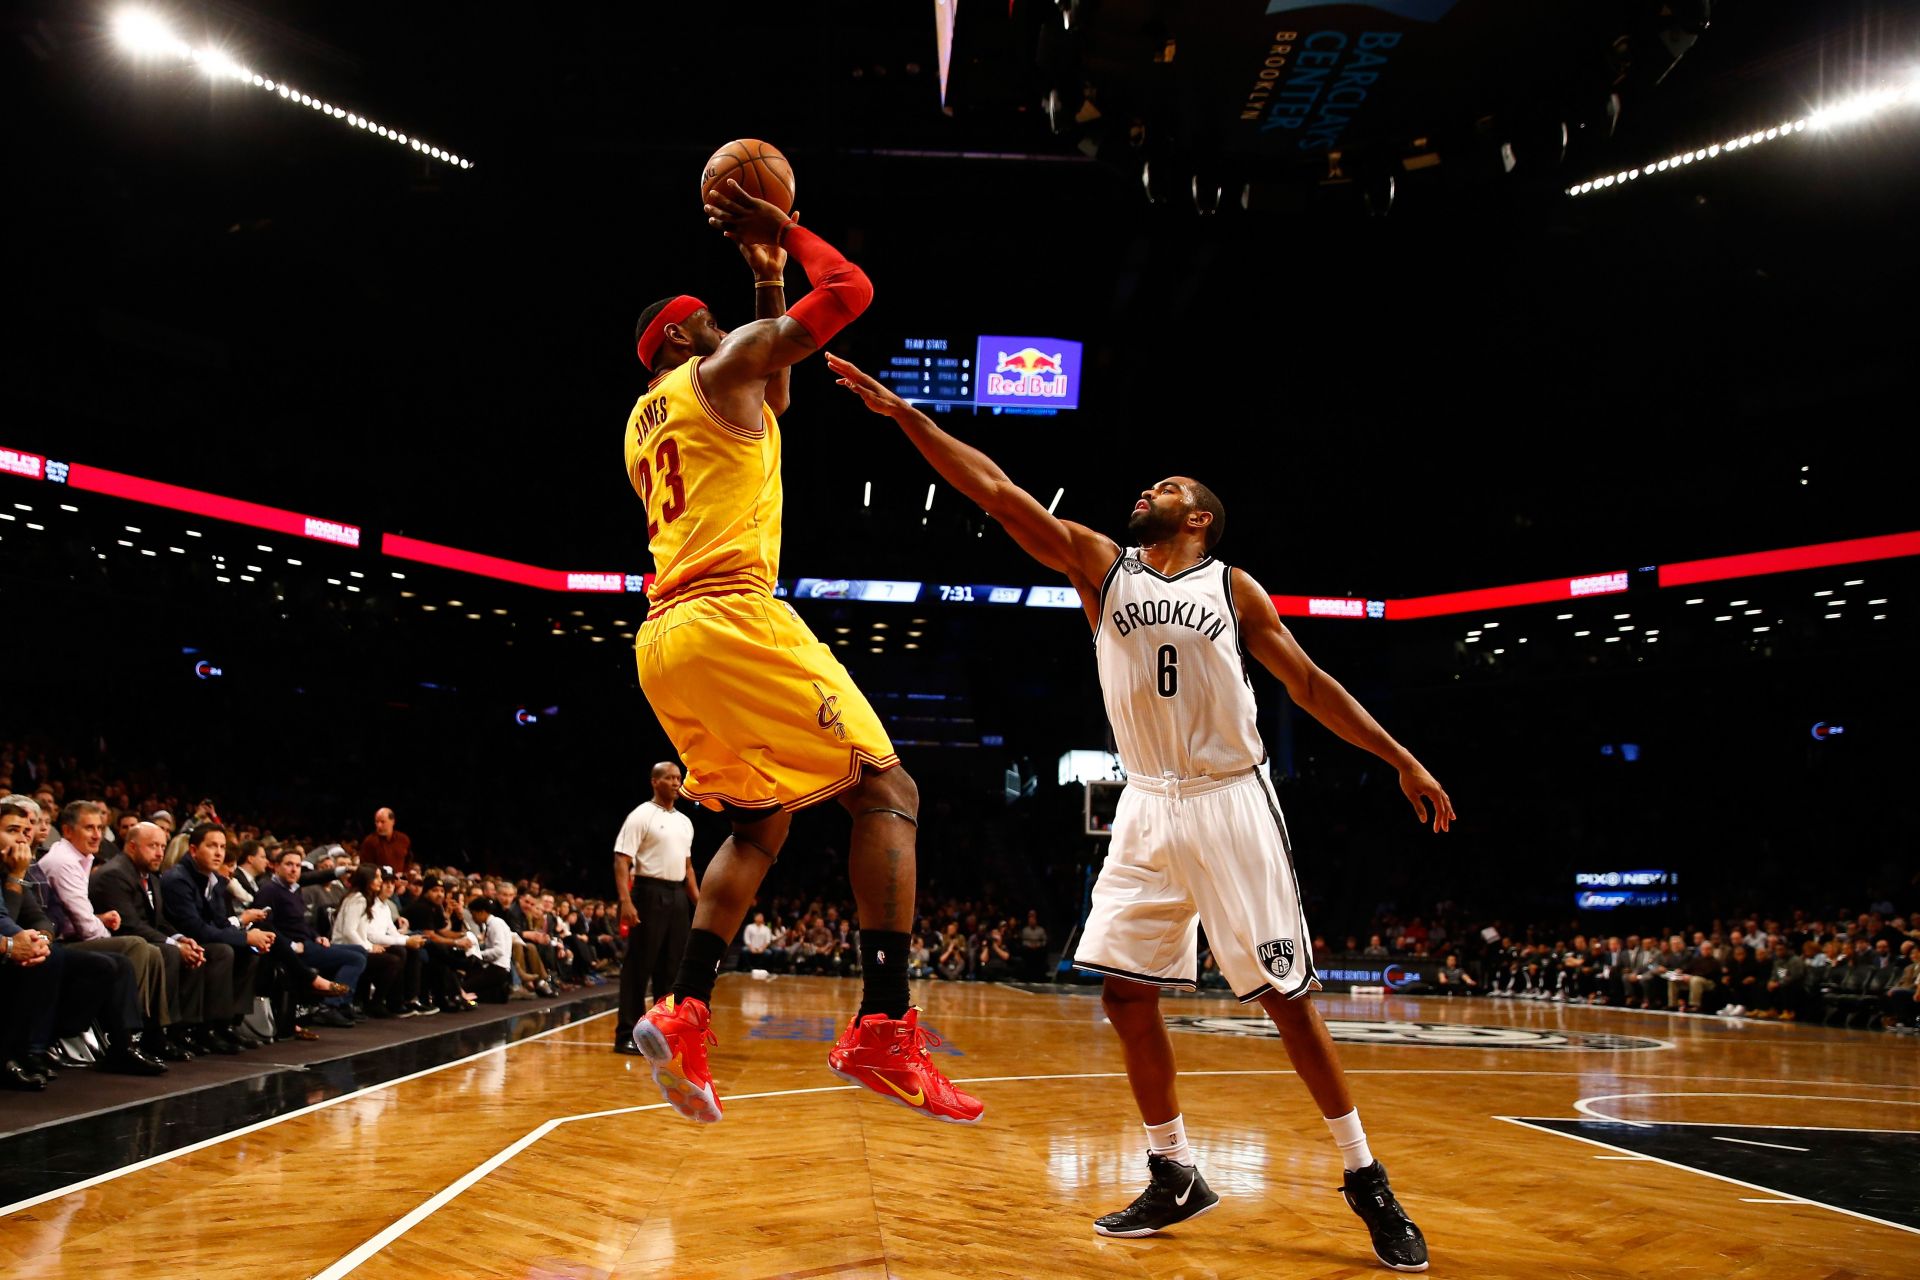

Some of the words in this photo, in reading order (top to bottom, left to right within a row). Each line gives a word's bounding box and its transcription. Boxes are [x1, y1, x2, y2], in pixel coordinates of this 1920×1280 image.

[1240, 31, 1297, 119] BROOKLYN
[1262, 30, 1347, 131] CENTER
[1299, 31, 1402, 149] BARCLAYS
[905, 339, 924, 349] TEAM
[925, 339, 948, 350] STATS
[989, 375, 1026, 394] Red
[1030, 377, 1066, 396] Bull
[635, 396, 667, 446] JAMES
[638, 438, 687, 540] 23
[884, 584, 894, 598] 7
[939, 585, 974, 601] 7:31
[1047, 590, 1066, 603] 14
[1112, 600, 1227, 641] BROOKLYN
[1157, 643, 1178, 698] 6
[1261, 940, 1293, 960] NETS
[1277, 959, 1284, 973] B
